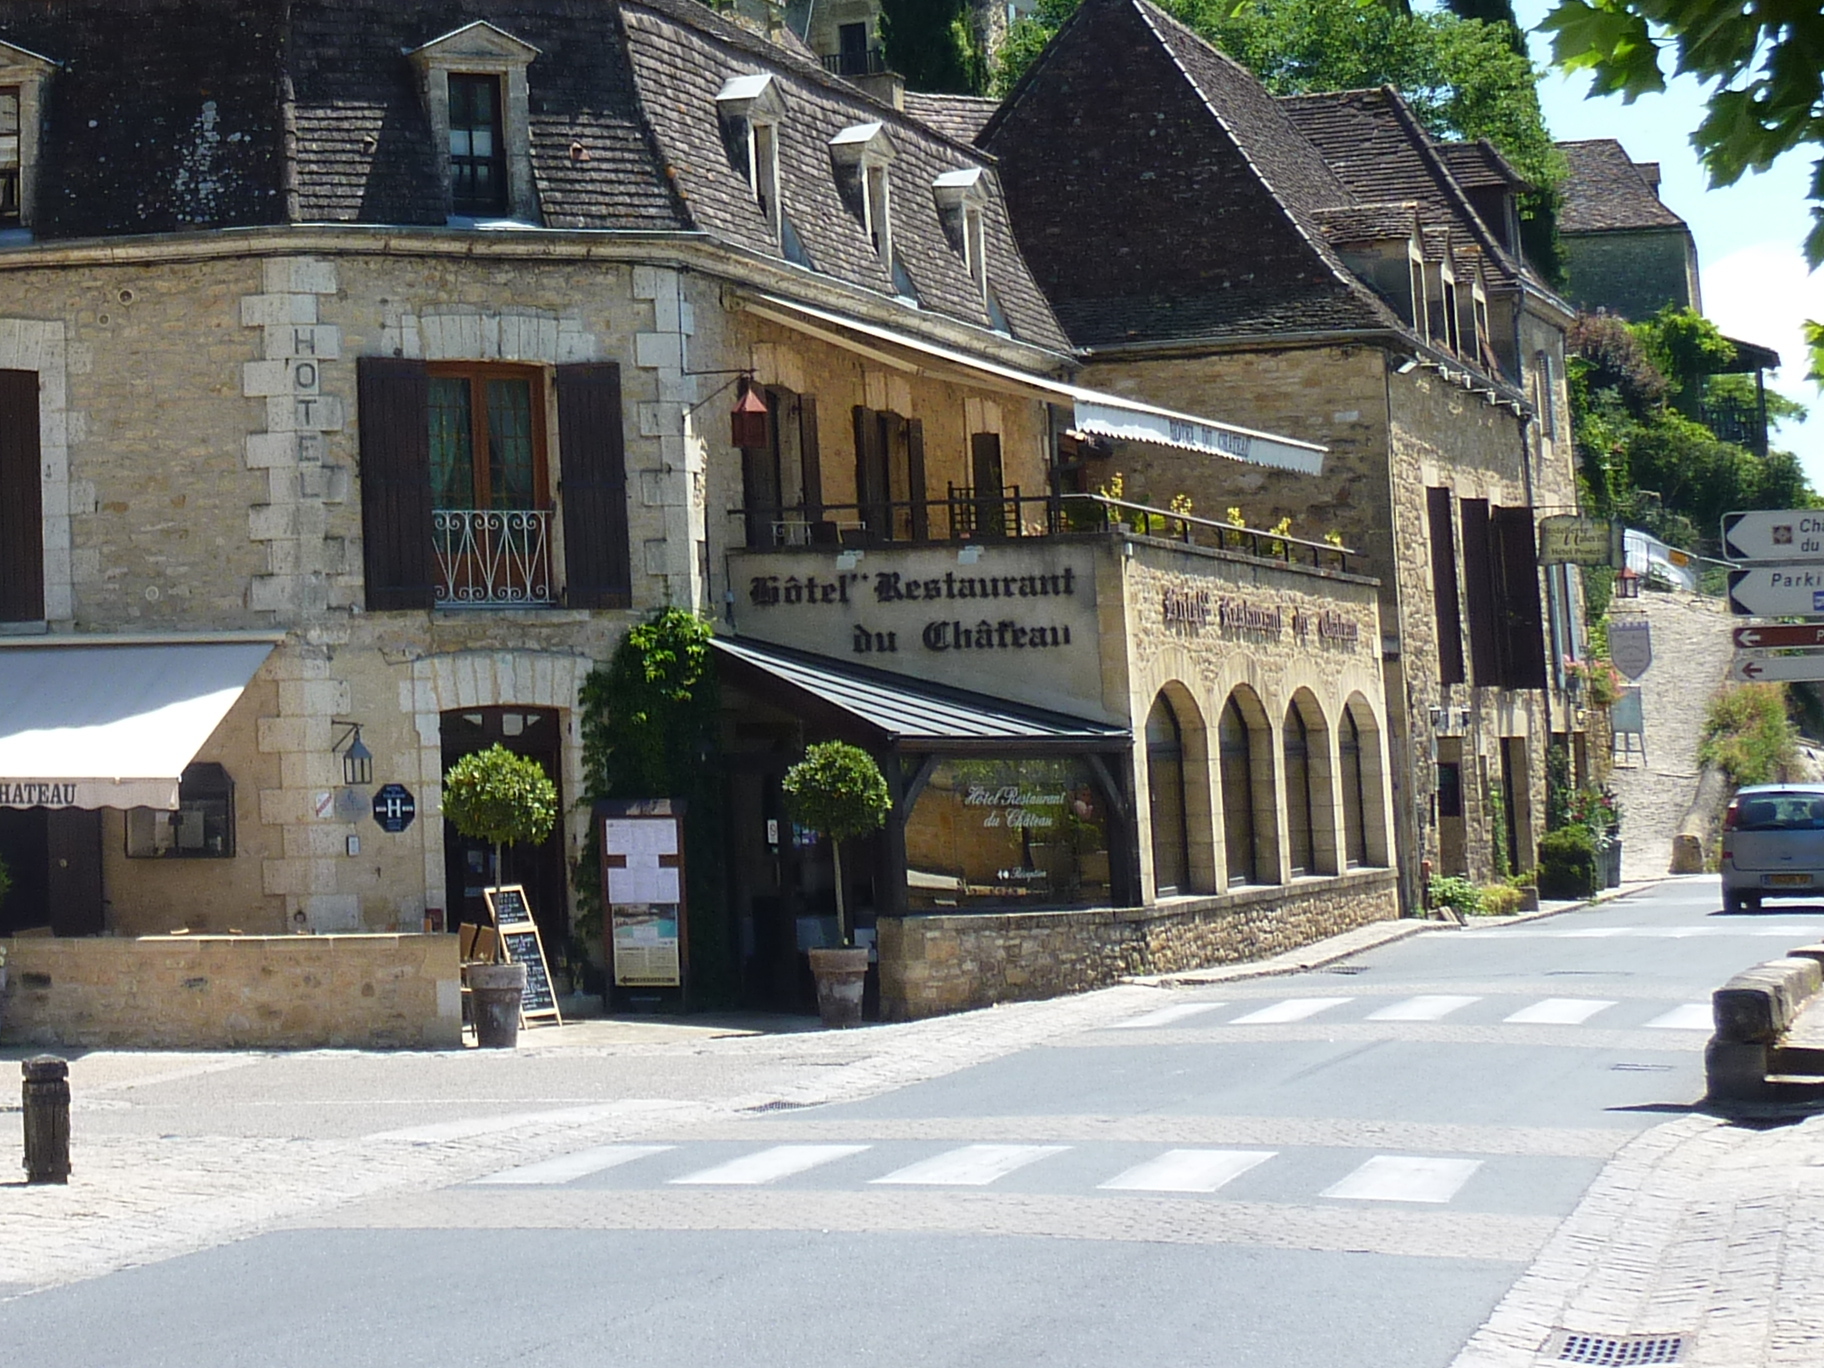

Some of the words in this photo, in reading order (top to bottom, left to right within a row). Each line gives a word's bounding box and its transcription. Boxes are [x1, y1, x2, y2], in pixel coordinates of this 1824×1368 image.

[293, 328, 321, 499] HOTEL
[1801, 538, 1820, 552] du
[749, 573, 850, 606] Hôtel
[873, 568, 1075, 603] Restaurant
[853, 623, 898, 653] du
[922, 620, 1071, 652] Château
[1001, 786, 1066, 806] Restaurant
[387, 798, 401, 818] H
[983, 810, 1000, 827] du
[1005, 808, 1053, 828] Château
